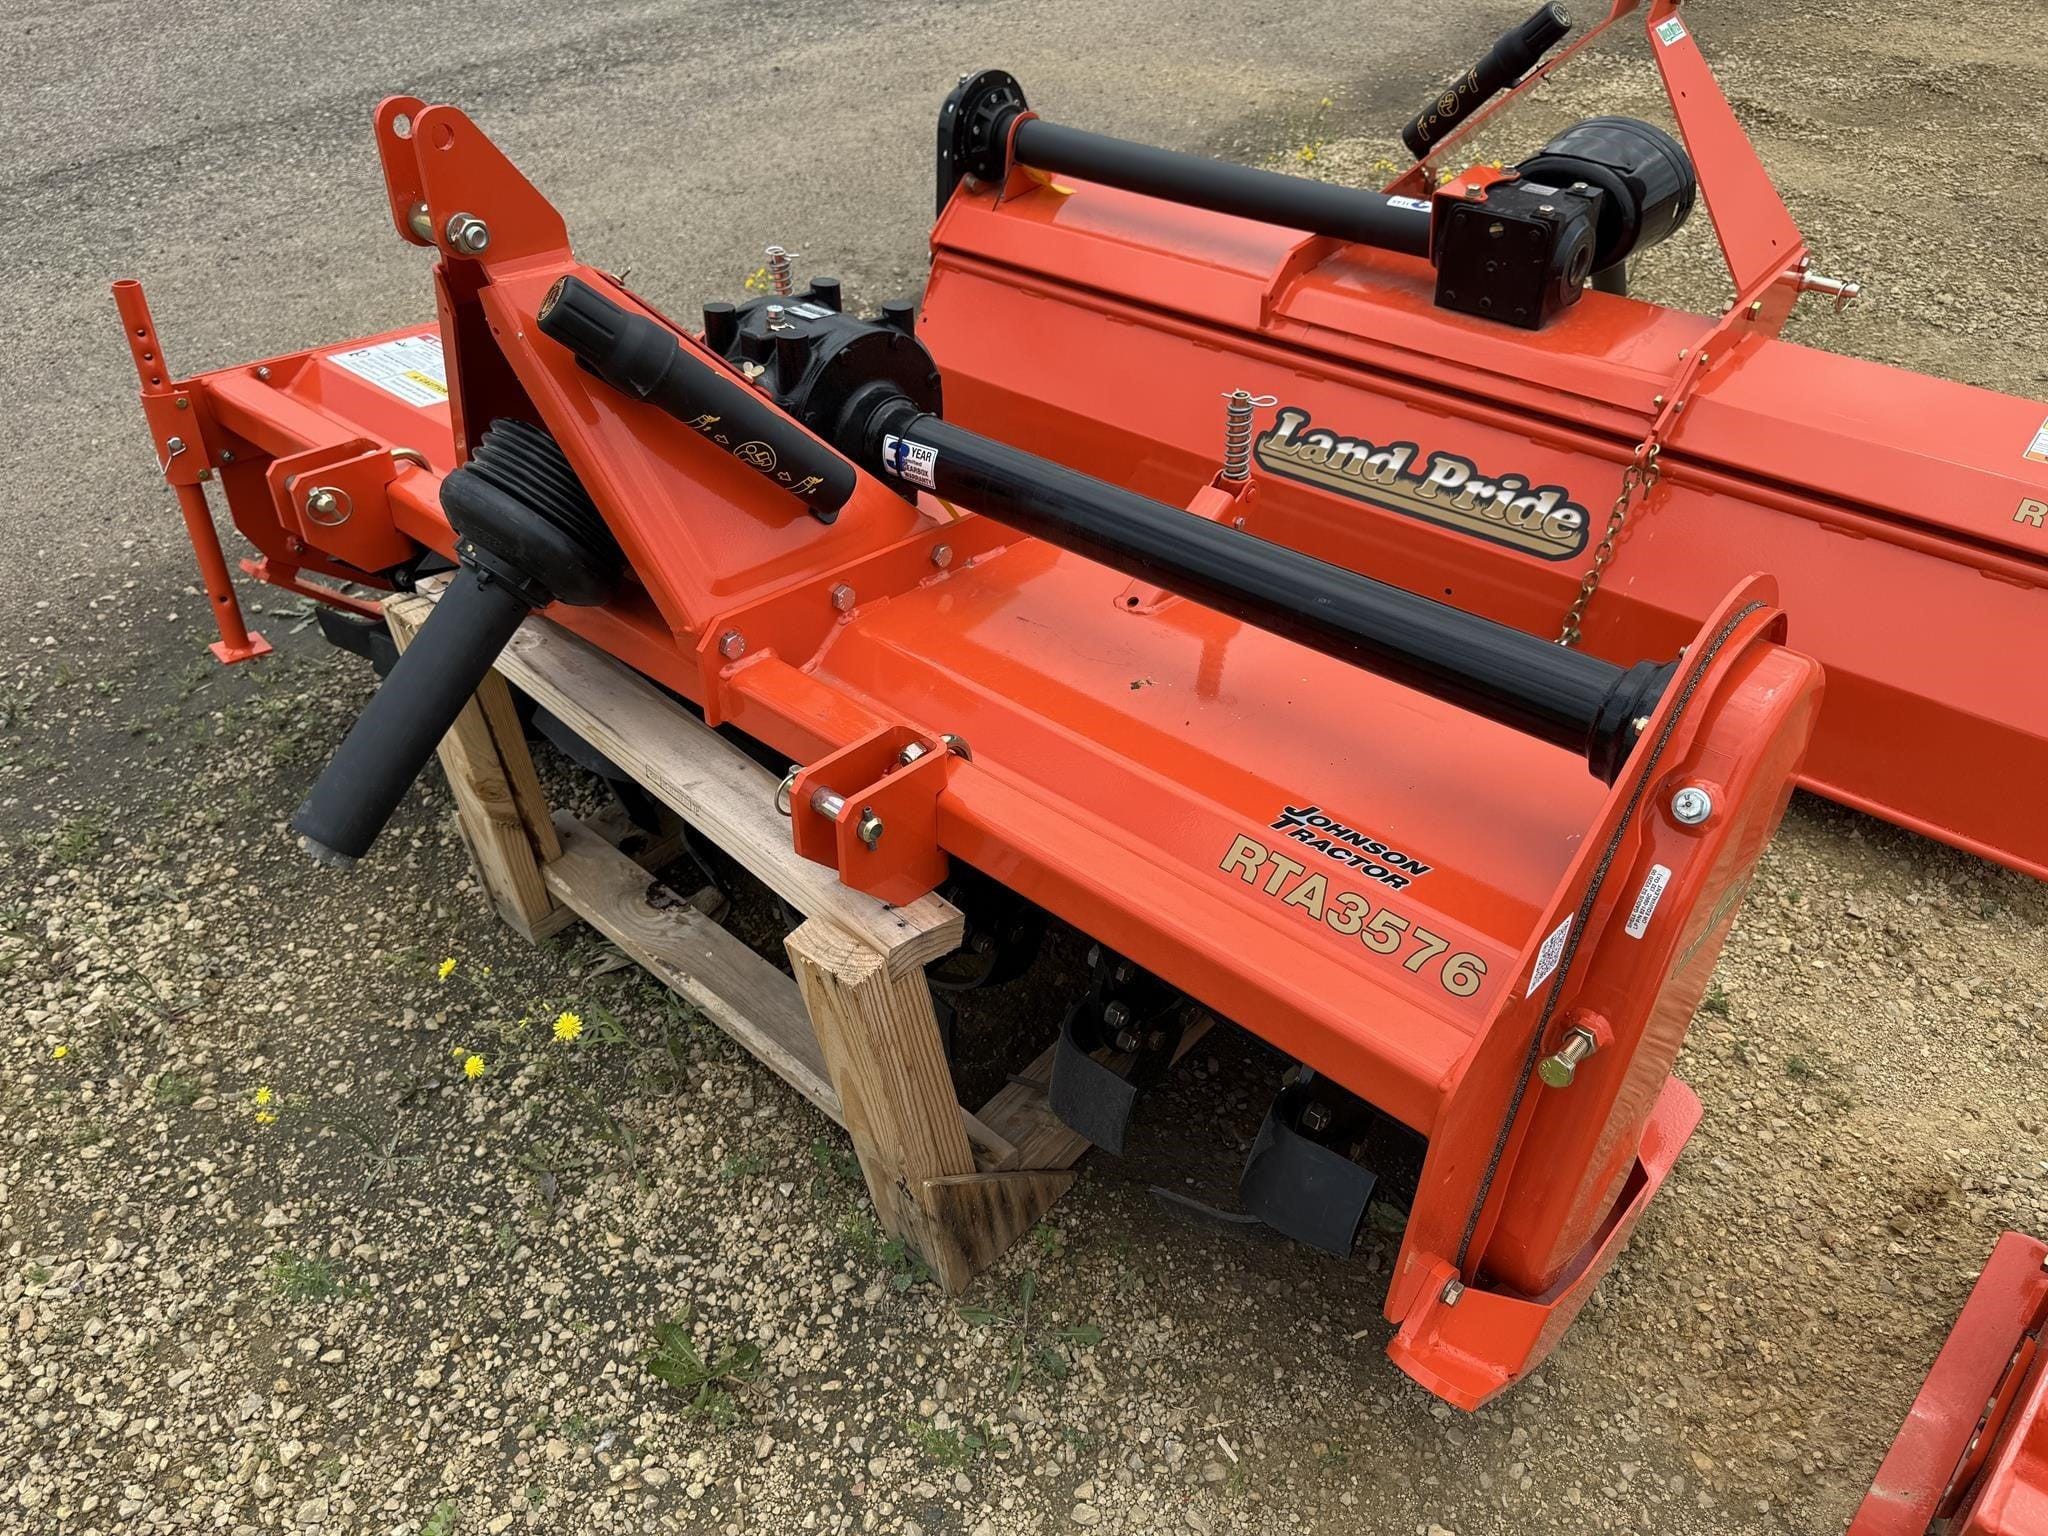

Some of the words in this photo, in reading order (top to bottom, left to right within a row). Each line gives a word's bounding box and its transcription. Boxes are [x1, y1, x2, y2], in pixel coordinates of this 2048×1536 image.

[911, 446, 932, 462] YEAR
[1261, 410, 1417, 486] Land
[1413, 454, 1584, 539] Pride
[1270, 814, 1411, 890] TRACTOR
[1284, 805, 1431, 876] JOHNSON
[1219, 833, 1488, 997] RTA3576
